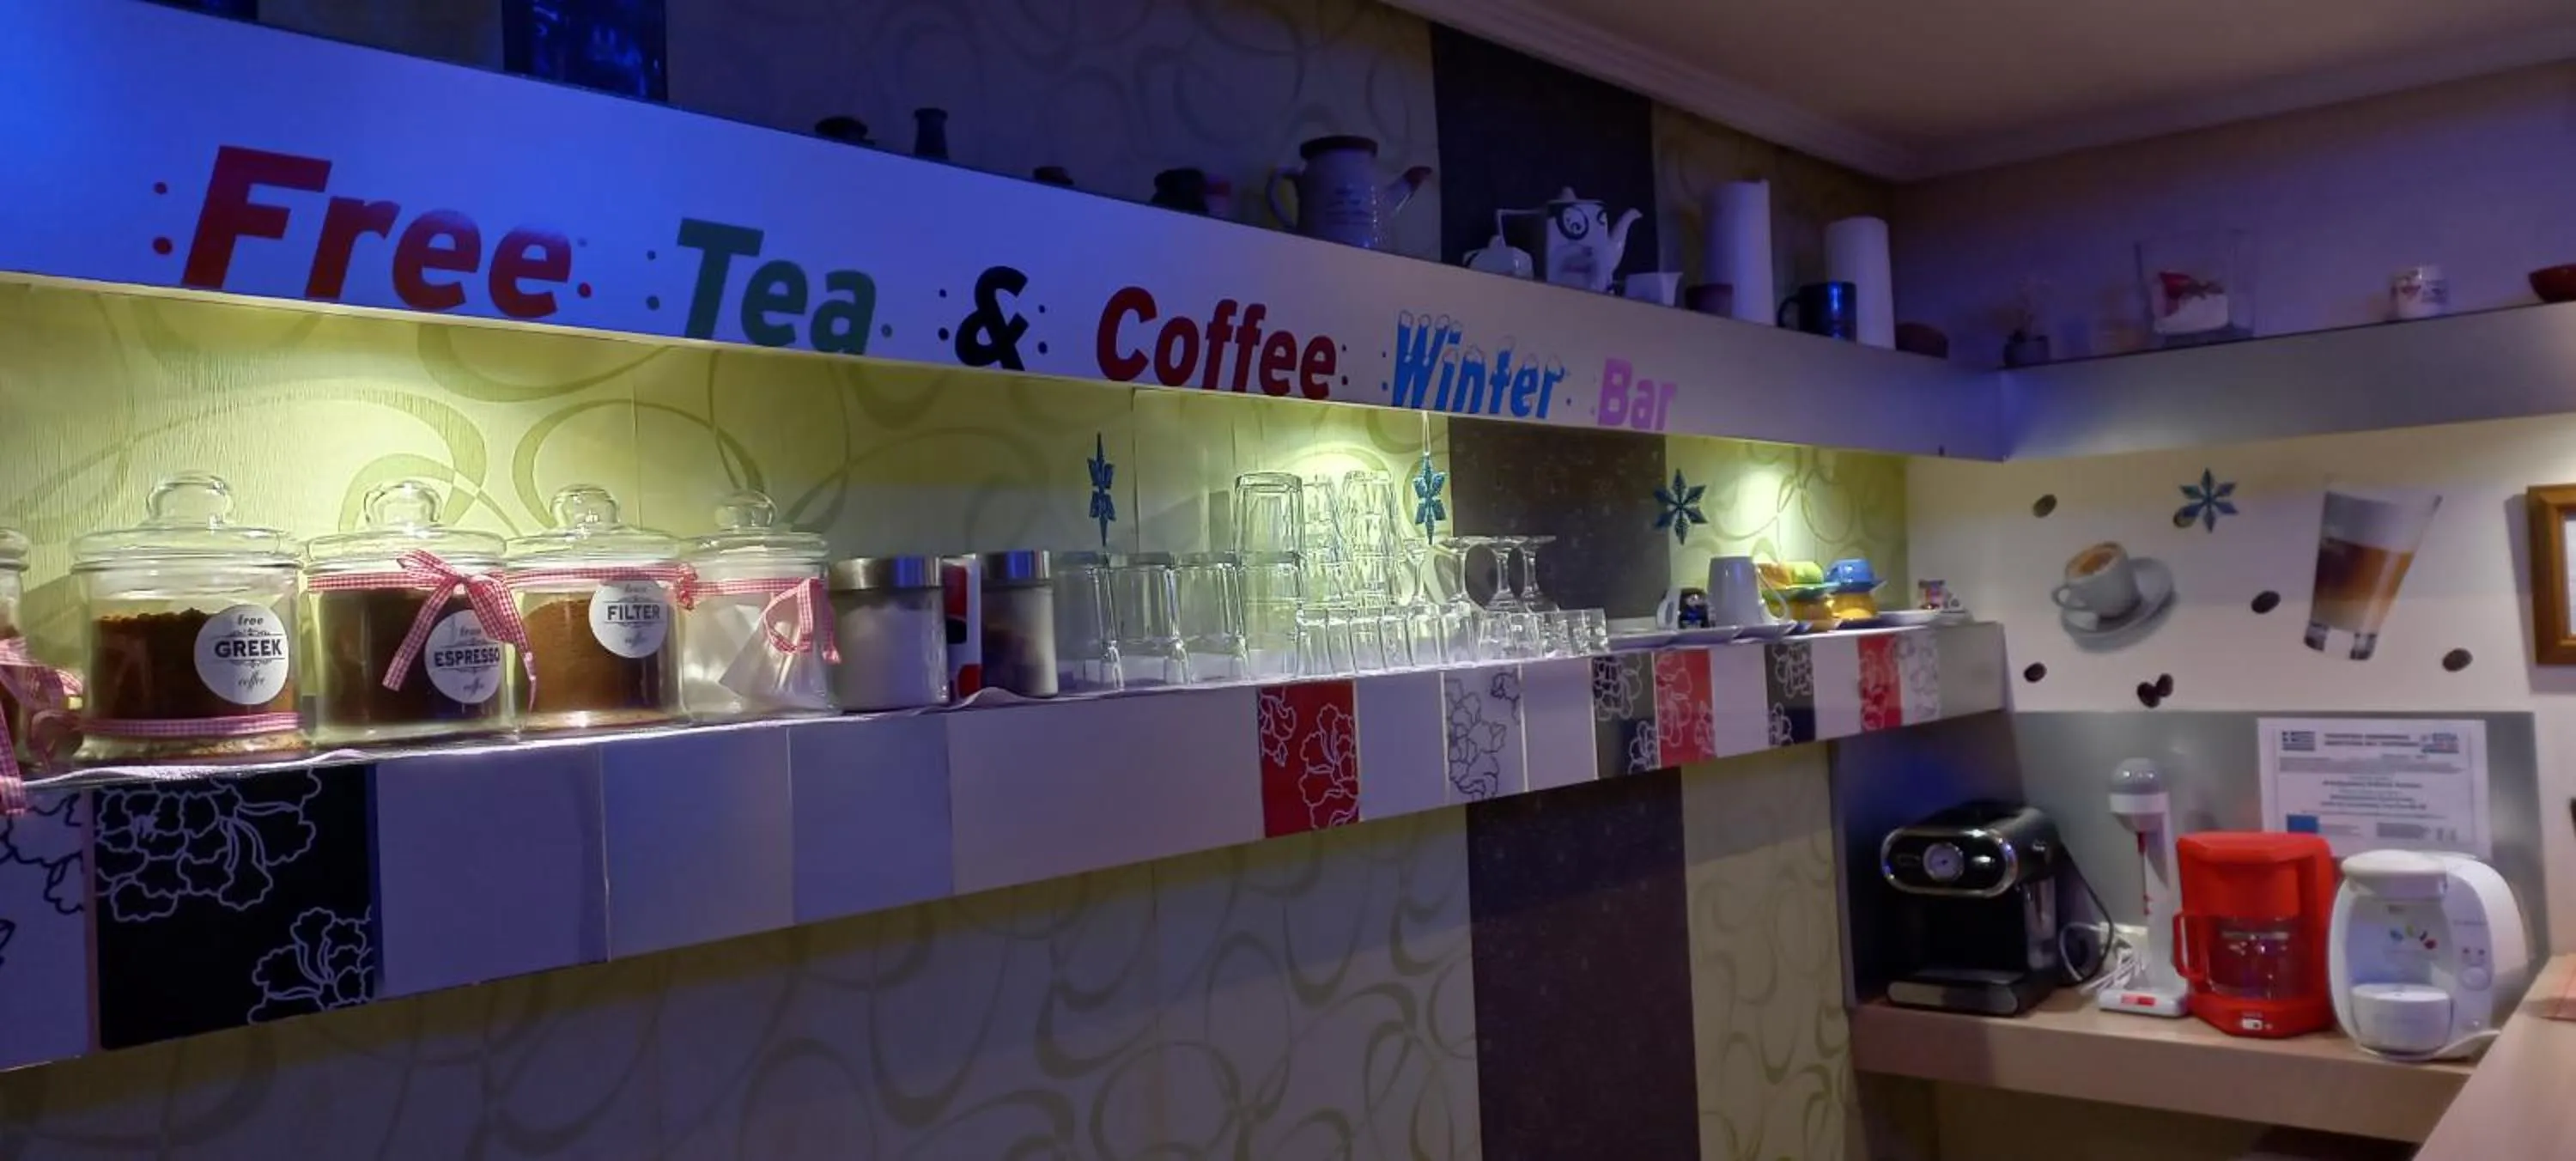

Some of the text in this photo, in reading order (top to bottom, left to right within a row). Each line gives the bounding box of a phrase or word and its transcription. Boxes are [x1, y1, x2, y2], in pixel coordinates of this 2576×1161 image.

[182, 145, 1677, 430] Free Tea & Coffee Winter Bar
[607, 604, 660, 620] FILTER
[214, 639, 283, 659] GREEK
[434, 647, 500, 667] ESPRESSO
